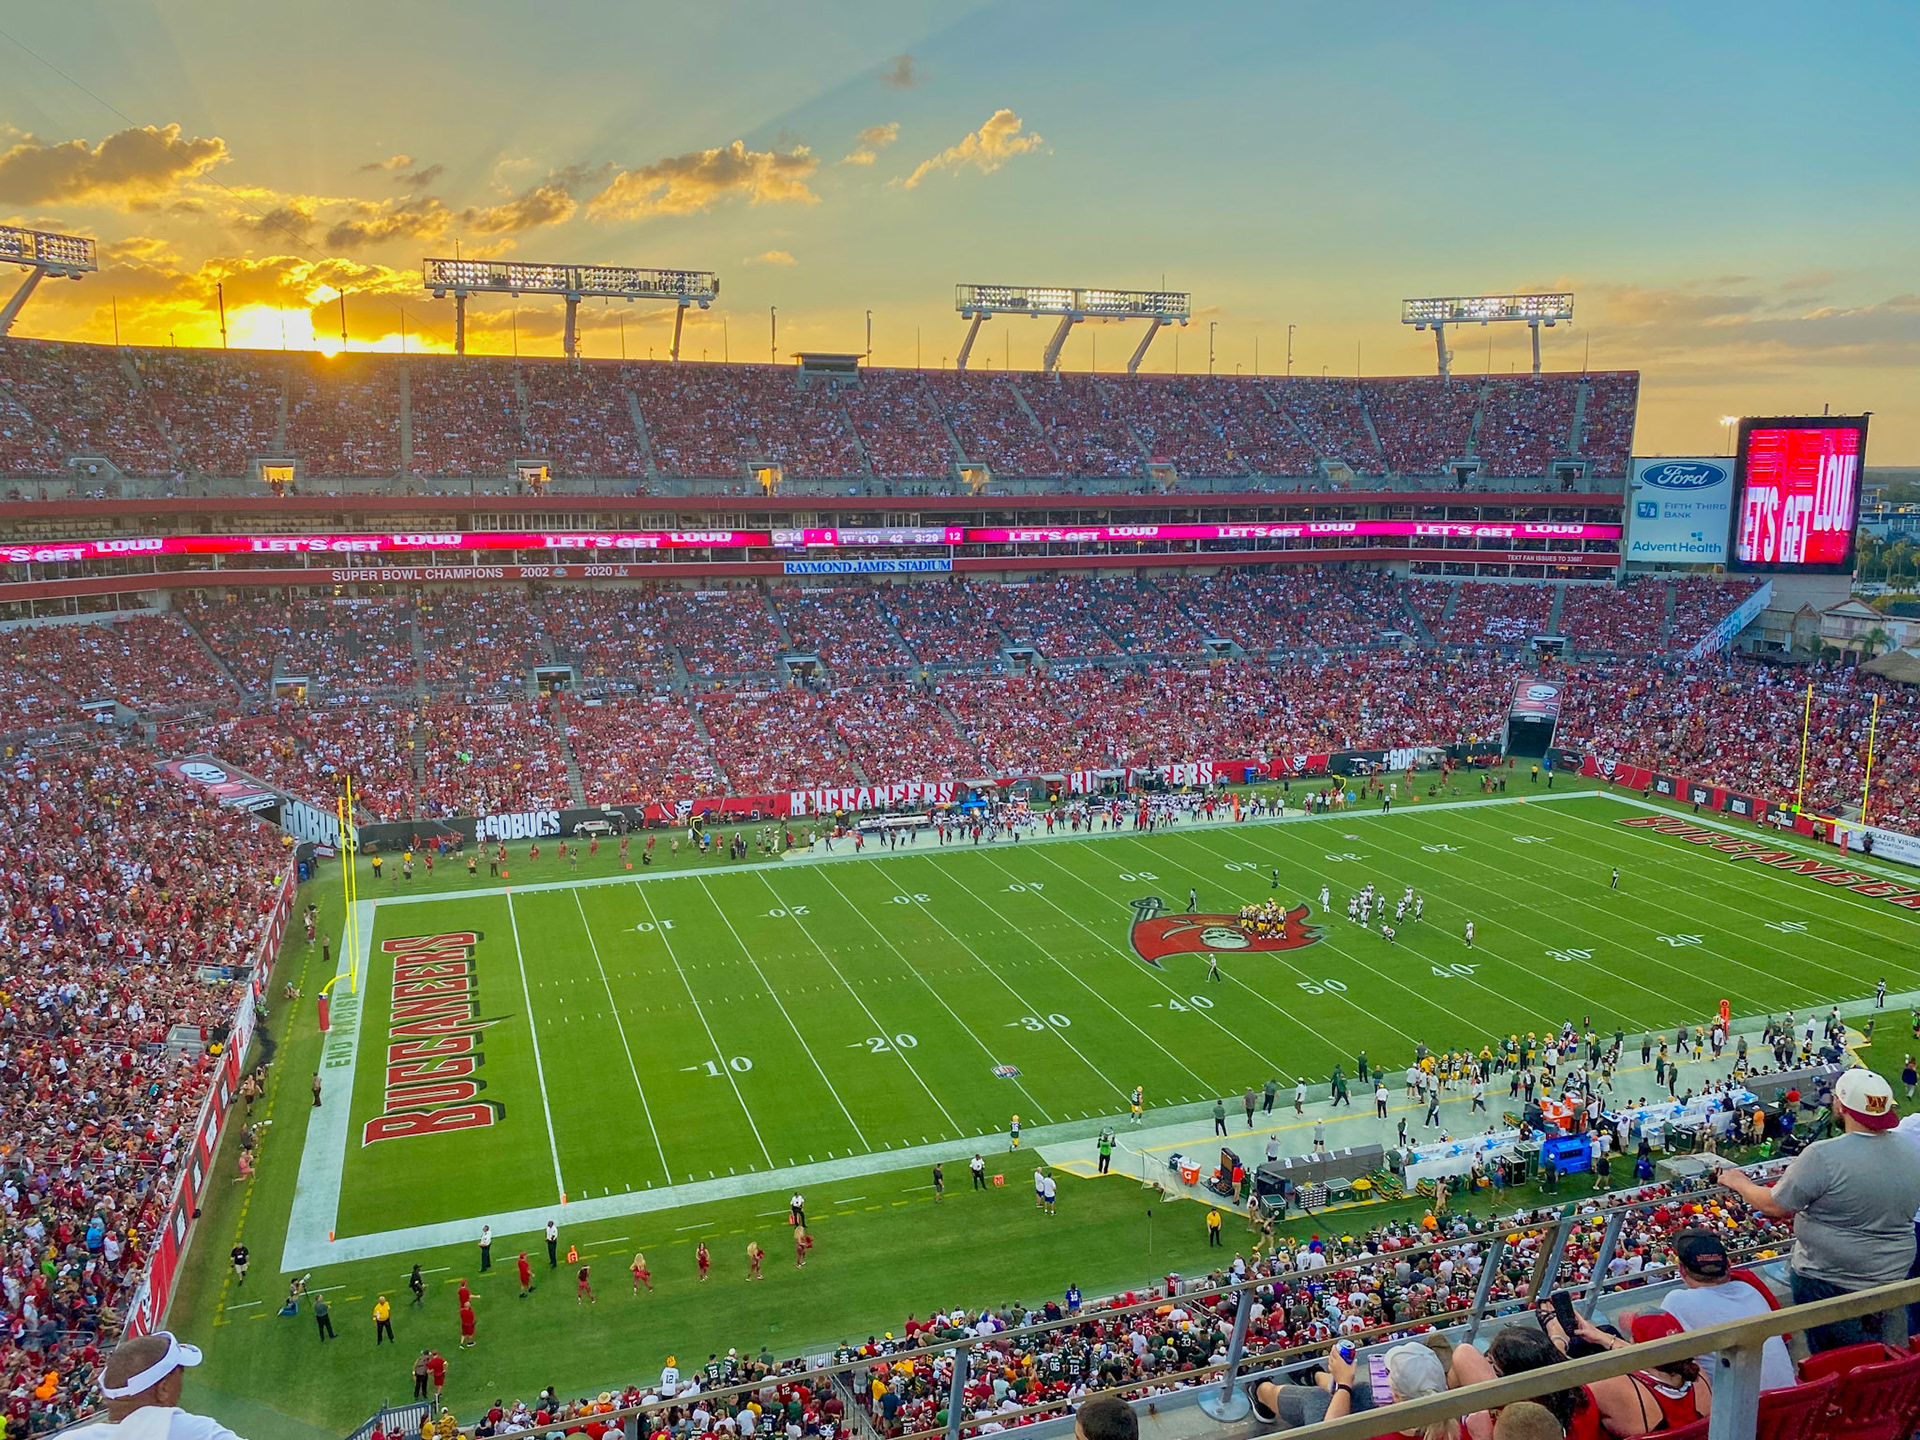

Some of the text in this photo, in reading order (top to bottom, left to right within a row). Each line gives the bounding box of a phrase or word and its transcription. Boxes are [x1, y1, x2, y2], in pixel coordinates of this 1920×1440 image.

[1657, 465, 1709, 484] Ford
[1009, 527, 1158, 541] LET'S GET LOUD
[1219, 523, 1356, 536] LET'S GET LOUD
[1416, 525, 1583, 536] LET'S GET LOUD
[1780, 495, 1813, 563] GET
[254, 535, 462, 551] LET'S GET LOUD
[547, 532, 731, 547] LET'S GET LOUD
[789, 533, 801, 541] 14
[824, 532, 832, 541] 6
[842, 535, 855, 543] 1ST
[867, 535, 879, 543] 10
[915, 534, 938, 542] 3:29
[35, 549, 85, 562] GET
[96, 539, 162, 552] LOUD
[1632, 541, 1722, 553] AdventHealth
[520, 567, 549, 578] 2002
[584, 566, 612, 577] 2020
[785, 560, 950, 574] RAYMOND JAMES STADIUM
[332, 567, 503, 581] SUPER BOWL CHAMPIONS
[791, 783, 955, 816] BUCCANEERS
[476, 811, 562, 841] #GOBUCS
[1764, 921, 1808, 934] 10
[1656, 934, 1703, 947] 20
[1545, 948, 1592, 962] 30
[1431, 963, 1475, 978] 40
[1297, 979, 1348, 995] 50
[1169, 995, 1215, 1012] 40
[1020, 1013, 1072, 1031] 30
[361, 931, 508, 1148] BUCCANEERS
[865, 1033, 918, 1053] 20
[325, 1041, 353, 1069] END
[702, 1056, 753, 1077] 10
[1285, 1300, 1294, 1308] 12
[1020, 1338, 1029, 1346] 33
[1181, 1338, 1191, 1347] 33
[709, 1370, 718, 1379] 12
[1069, 1365, 1080, 1375] 12
[666, 1375, 674, 1384] 12
[781, 1386, 790, 1395] 12
[903, 1427, 913, 1435] 12
